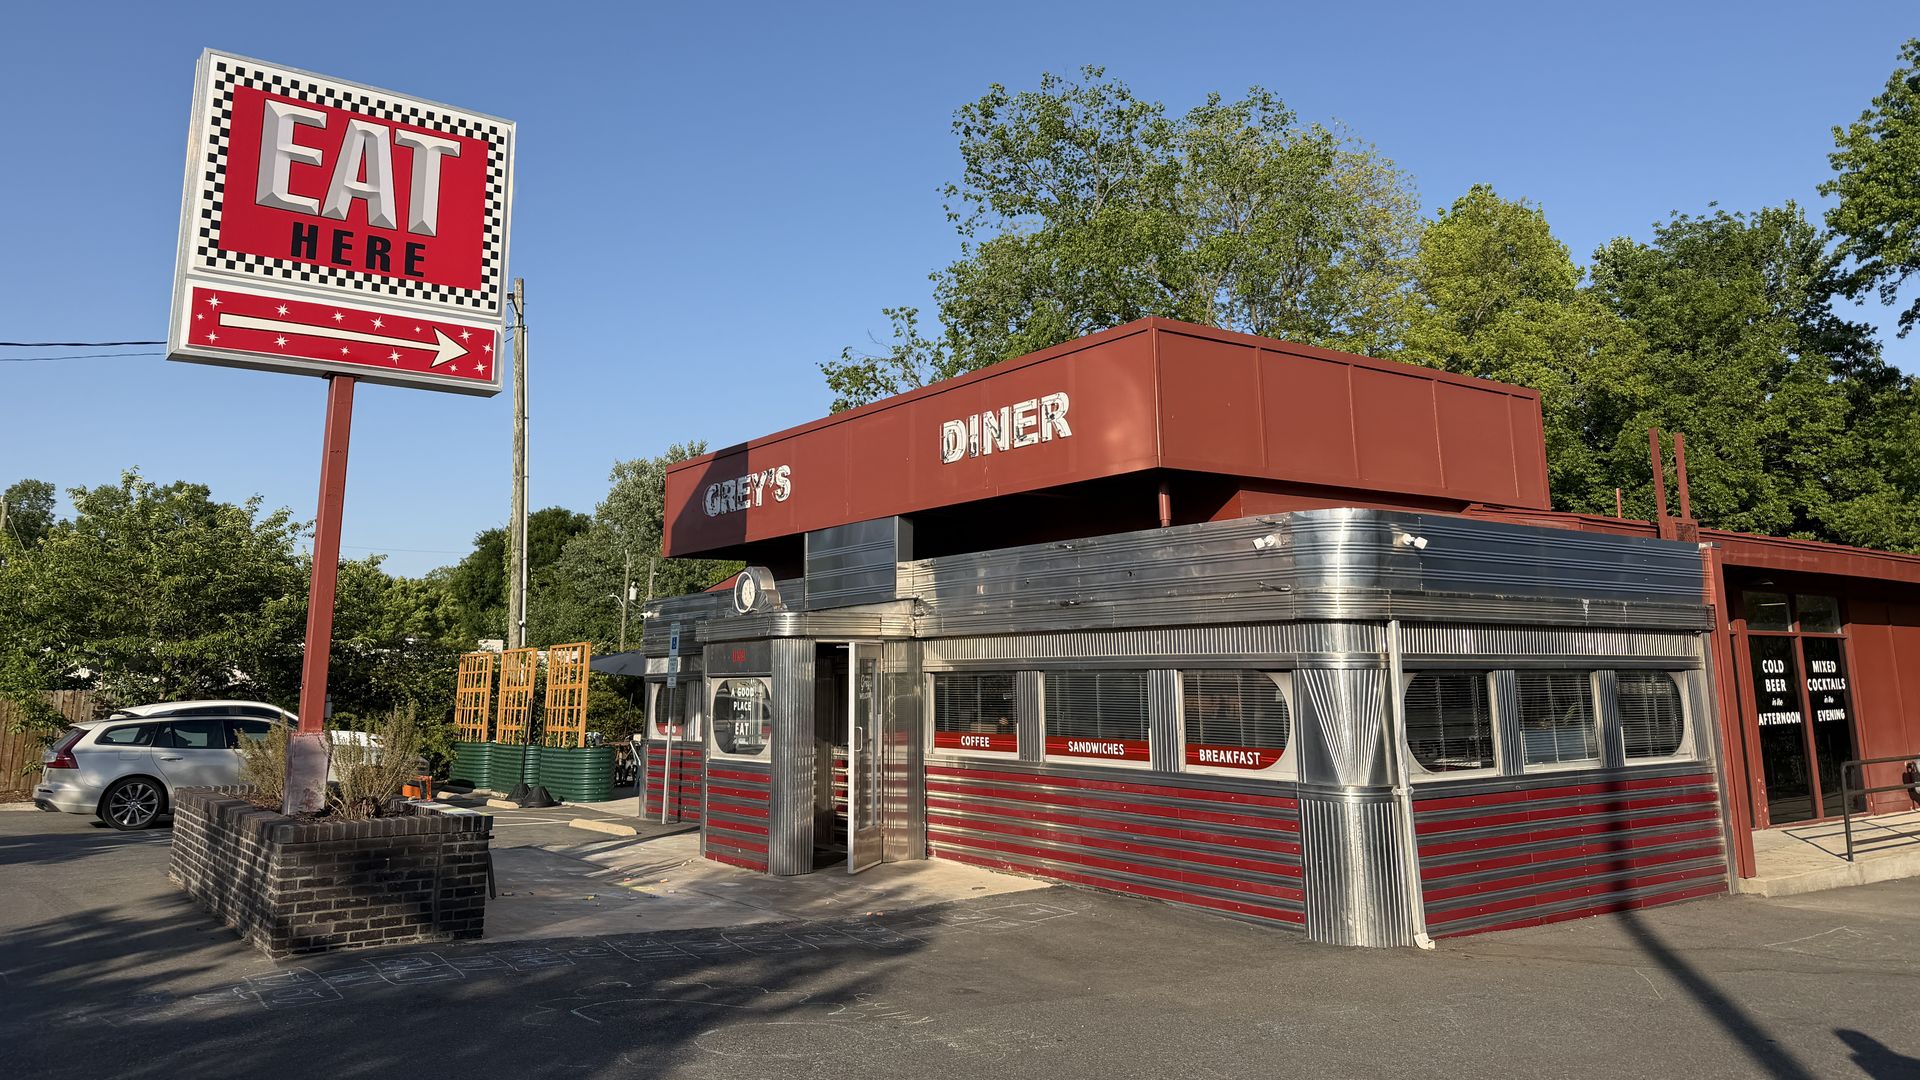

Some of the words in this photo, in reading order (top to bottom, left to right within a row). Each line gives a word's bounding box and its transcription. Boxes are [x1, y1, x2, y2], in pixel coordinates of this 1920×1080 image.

[255, 98, 461, 237] EAT
[290, 221, 426, 278] HERE
[703, 464, 791, 517] GREY'S
[940, 391, 1072, 465] DINER
[1762, 659, 1784, 673] COLD
[1812, 660, 1836, 673] MIXED
[1765, 678, 1787, 693] BEER
[1807, 678, 1846, 691] COCKTAILS
[730, 687, 736, 697] A
[737, 687, 754, 697] GOOD
[733, 701, 751, 711] PLACE
[1758, 711, 1801, 726] AFTERNOON
[1817, 708, 1845, 722] EVENING
[735, 722, 750, 736] EAT
[960, 735, 990, 748] COFFEE
[1067, 740, 1125, 756] SANDWICHES
[1199, 748, 1261, 766] BREAKFAST
